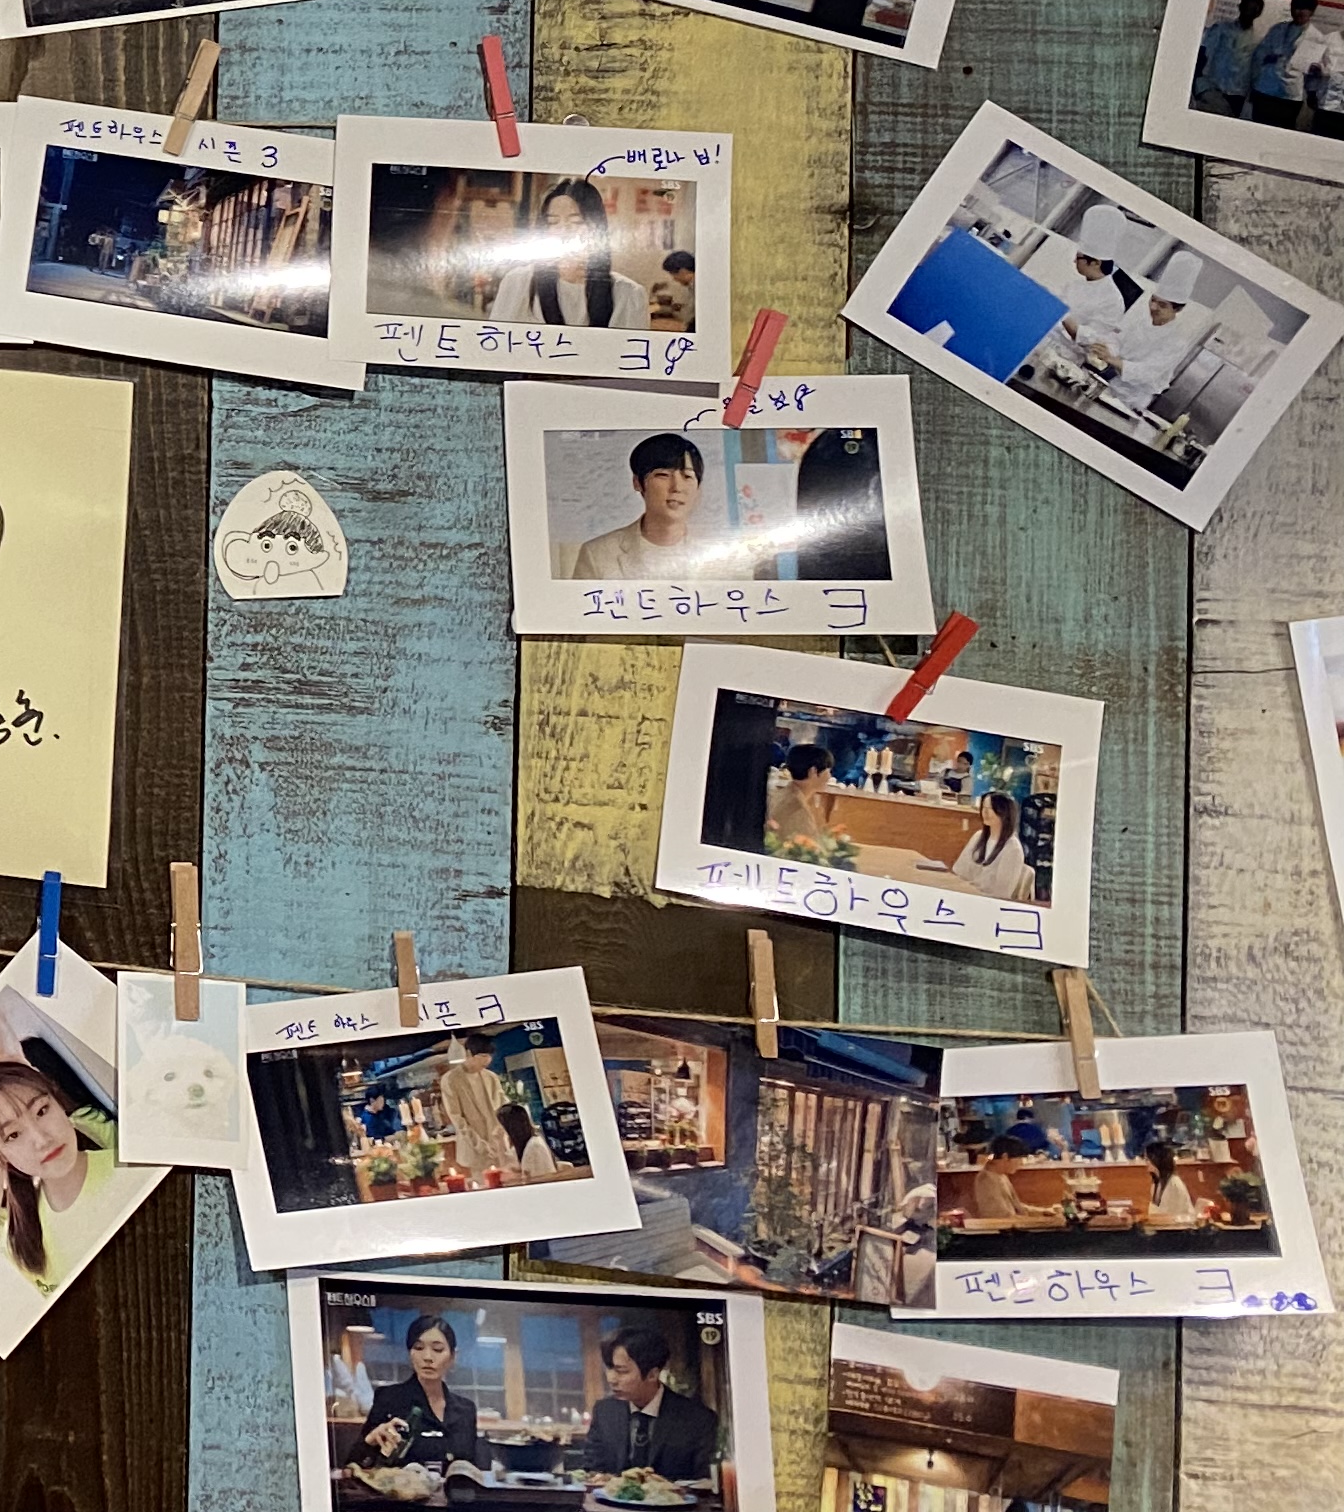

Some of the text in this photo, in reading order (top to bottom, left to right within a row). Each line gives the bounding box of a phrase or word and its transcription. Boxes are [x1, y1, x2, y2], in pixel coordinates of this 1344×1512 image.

[260, 146, 279, 169] 3
[660, 179, 681, 190] SBS
[374, 322, 579, 363] 펜트하우스
[583, 587, 790, 620] 펜트하우스
[1022, 742, 1044, 754] SBS
[523, 1021, 544, 1031] SBS
[1208, 1086, 1231, 1097] SBS
[696, 1312, 724, 1325] SBS
